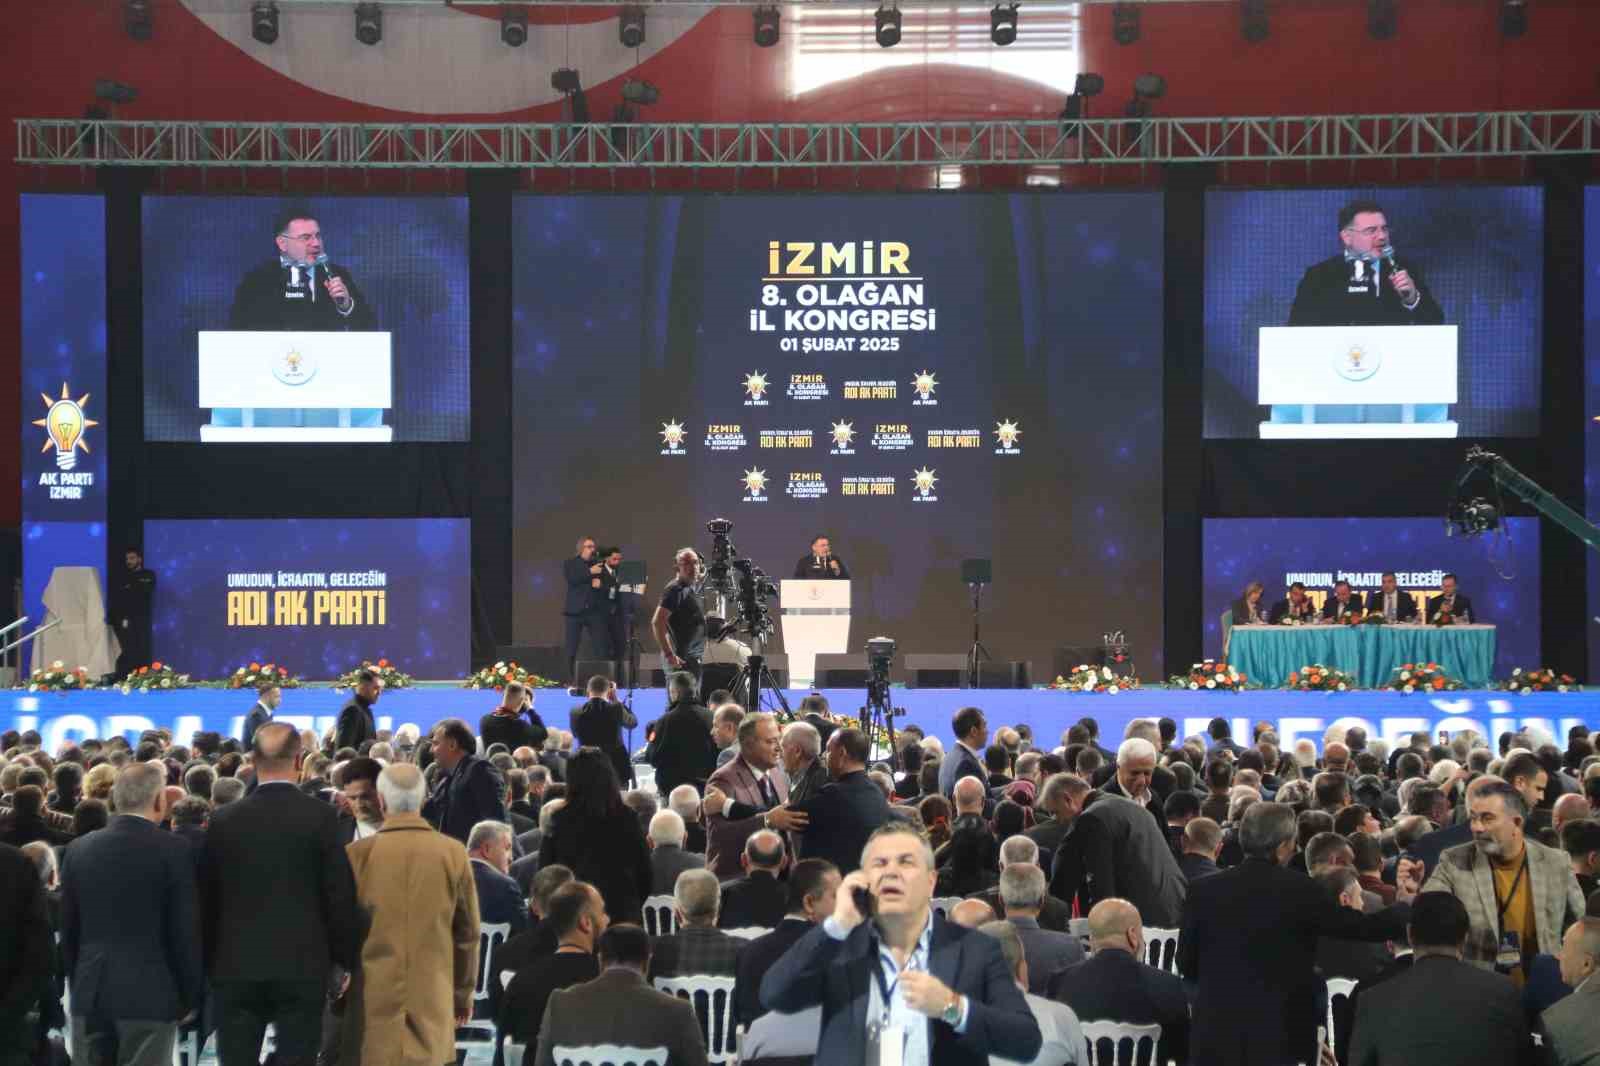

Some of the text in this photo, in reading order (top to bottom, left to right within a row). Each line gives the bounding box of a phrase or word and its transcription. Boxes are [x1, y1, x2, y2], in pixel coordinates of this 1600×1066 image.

[762, 282, 923, 306] 8. OLAĞAN
[750, 308, 936, 331] İL KONGRESİ
[780, 337, 900, 353] 01 ŞUBAT 2025
[860, 387, 870, 398] AK
[776, 436, 786, 448] AK
[943, 436, 954, 447] AK
[39, 473, 57, 485] AK
[858, 484, 868, 495] AK
[227, 573, 276, 588] UMUDUN,
[330, 570, 387, 587] GELECEĞİN
[227, 591, 268, 626] ADI
[274, 591, 308, 626] AK
